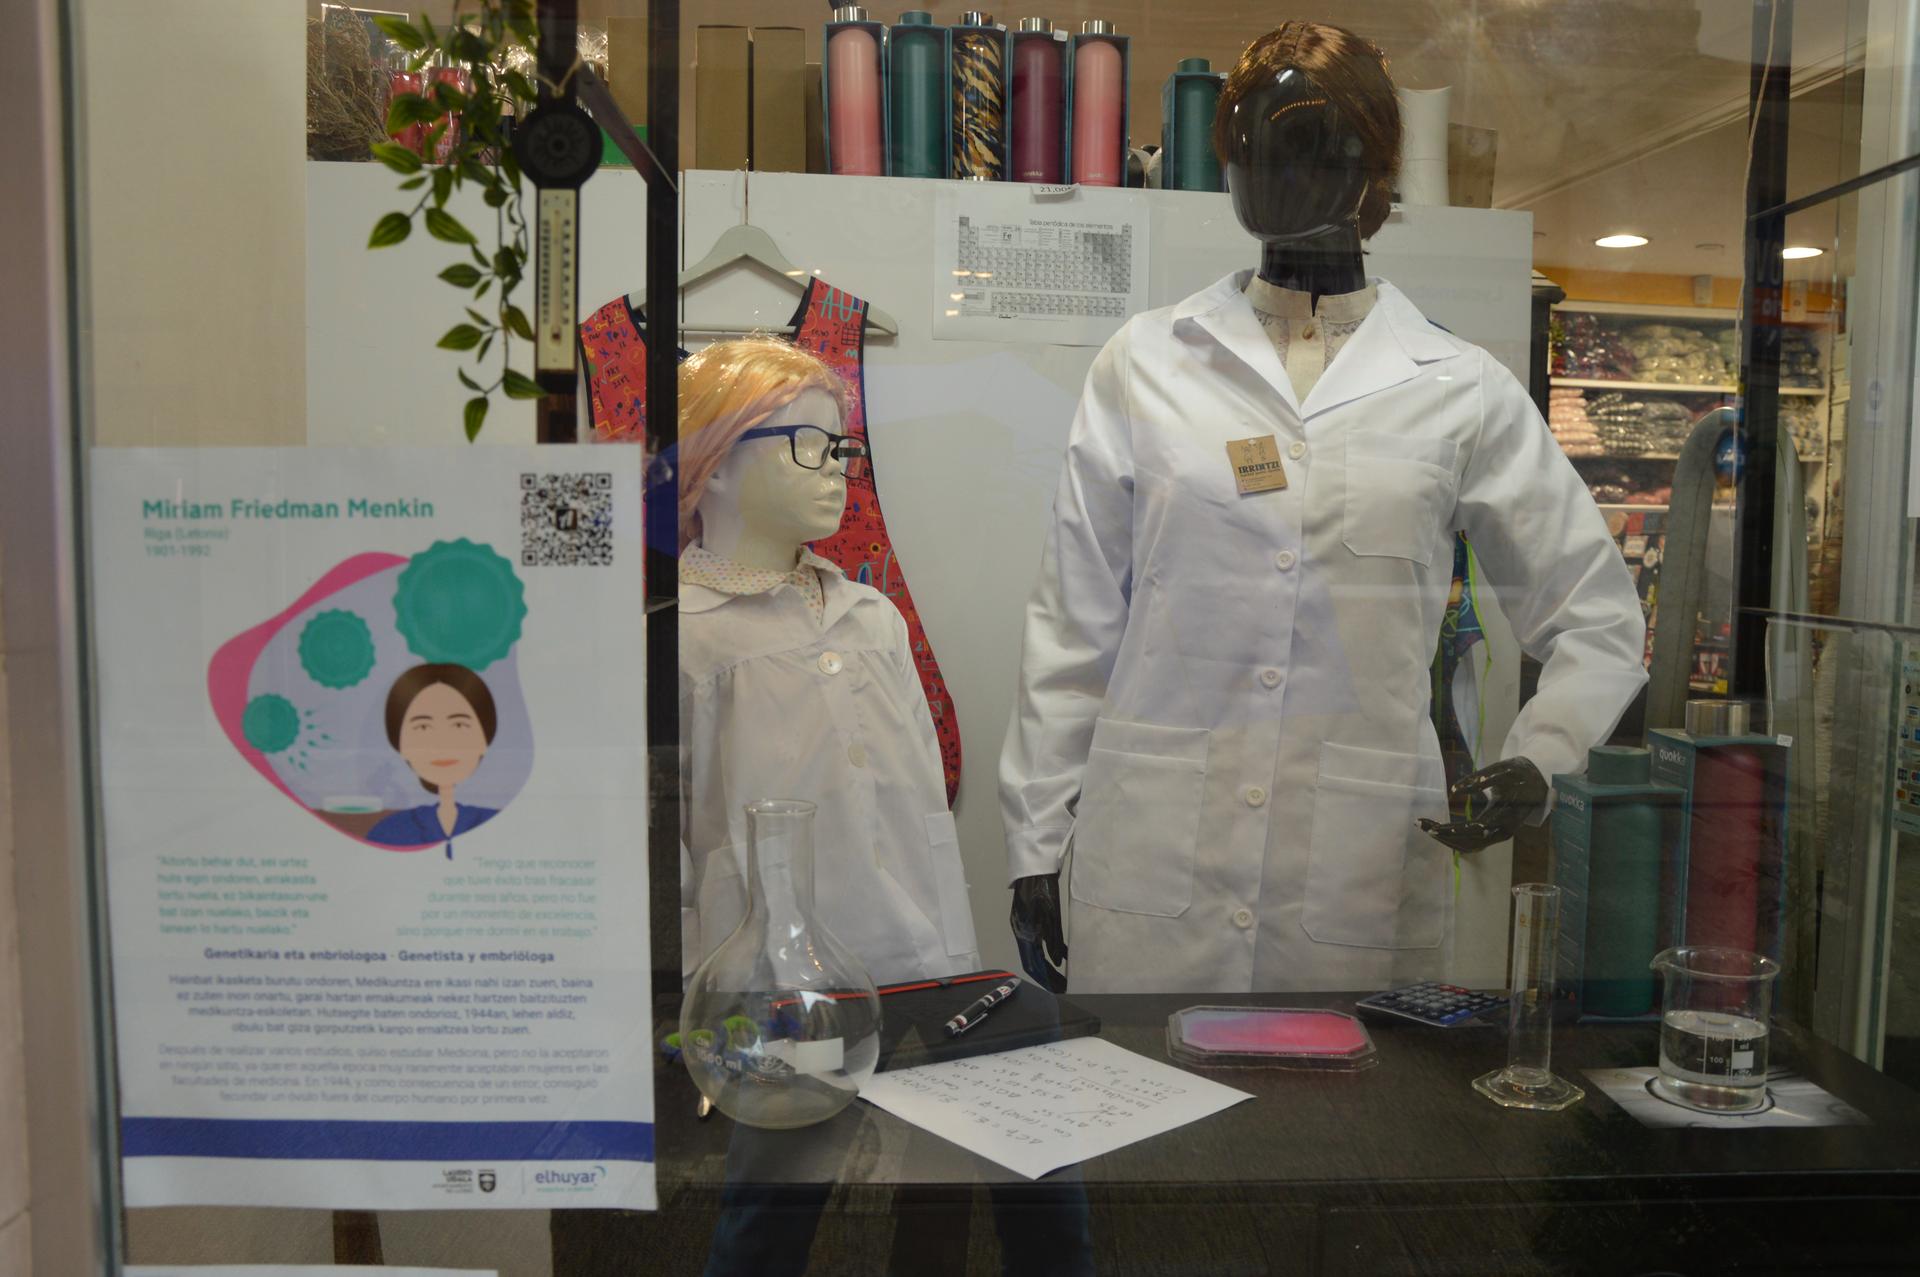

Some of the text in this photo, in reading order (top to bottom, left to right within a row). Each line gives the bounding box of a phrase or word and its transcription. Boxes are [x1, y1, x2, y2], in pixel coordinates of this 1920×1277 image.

[142, 497, 434, 519] Miriam Friedman Menkin
[1659, 748, 1686, 767] quokka
[204, 948, 554, 964] Genetikaria eta enbriologoa Genetista y embrióloga
[169, 974, 214, 986] Hainbat
[216, 974, 264, 986] ikasketa
[266, 975, 303, 986] burutu
[357, 975, 424, 987] Medikuntza
[426, 978, 444, 987] ere
[446, 976, 474, 987] ikasi
[475, 976, 501, 987] nahi
[502, 976, 527, 988] izan
[561, 976, 593, 988] baina
[176, 992, 191, 1001] ez
[193, 991, 225, 1001] zuten
[227, 990, 252, 1002] inon
[296, 991, 326, 1004] garai
[327, 991, 365, 1002] hartan
[367, 991, 437, 1003] emakumeak
[439, 992, 473, 1003] nekez
[475, 992, 519, 1003] hartzen
[520, 992, 587, 1004] baitzituzten
[318, 1006, 373, 1020] Hutsegite
[375, 1006, 408, 1018] baten
[512, 1008, 544, 1019] lehen
[232, 1021, 264, 1032] obulu
[266, 1021, 285, 1033] bat
[287, 1022, 311, 1035] giza
[313, 1022, 377, 1036] gorputzetik
[379, 1022, 414, 1036] kanpo
[416, 1022, 468, 1034] ernaltzea
[470, 1023, 497, 1034] lortu
[1709, 1056, 1724, 1064] 100
[535, 1169, 597, 1186] elhuyar
